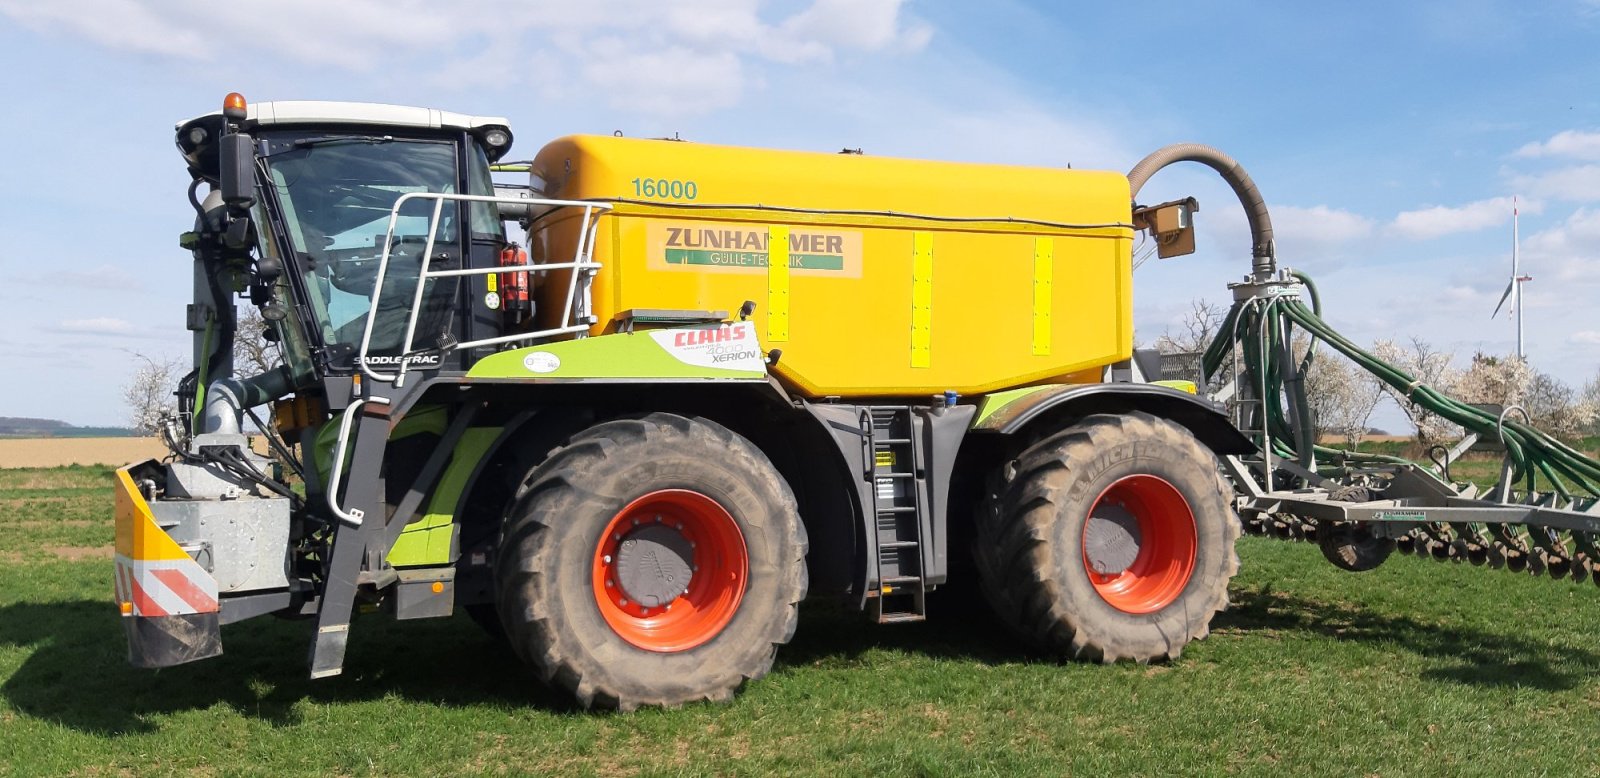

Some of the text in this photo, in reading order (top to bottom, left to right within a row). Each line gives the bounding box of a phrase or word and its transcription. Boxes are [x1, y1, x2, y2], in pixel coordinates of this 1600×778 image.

[631, 177, 698, 200] 16000
[666, 227, 843, 254] ZUNHAMER
[710, 252, 803, 267] GÜLLE-TEIK
[674, 325, 746, 348] CLAAS
[705, 344, 744, 356] 4000
[711, 350, 756, 364] XERION
